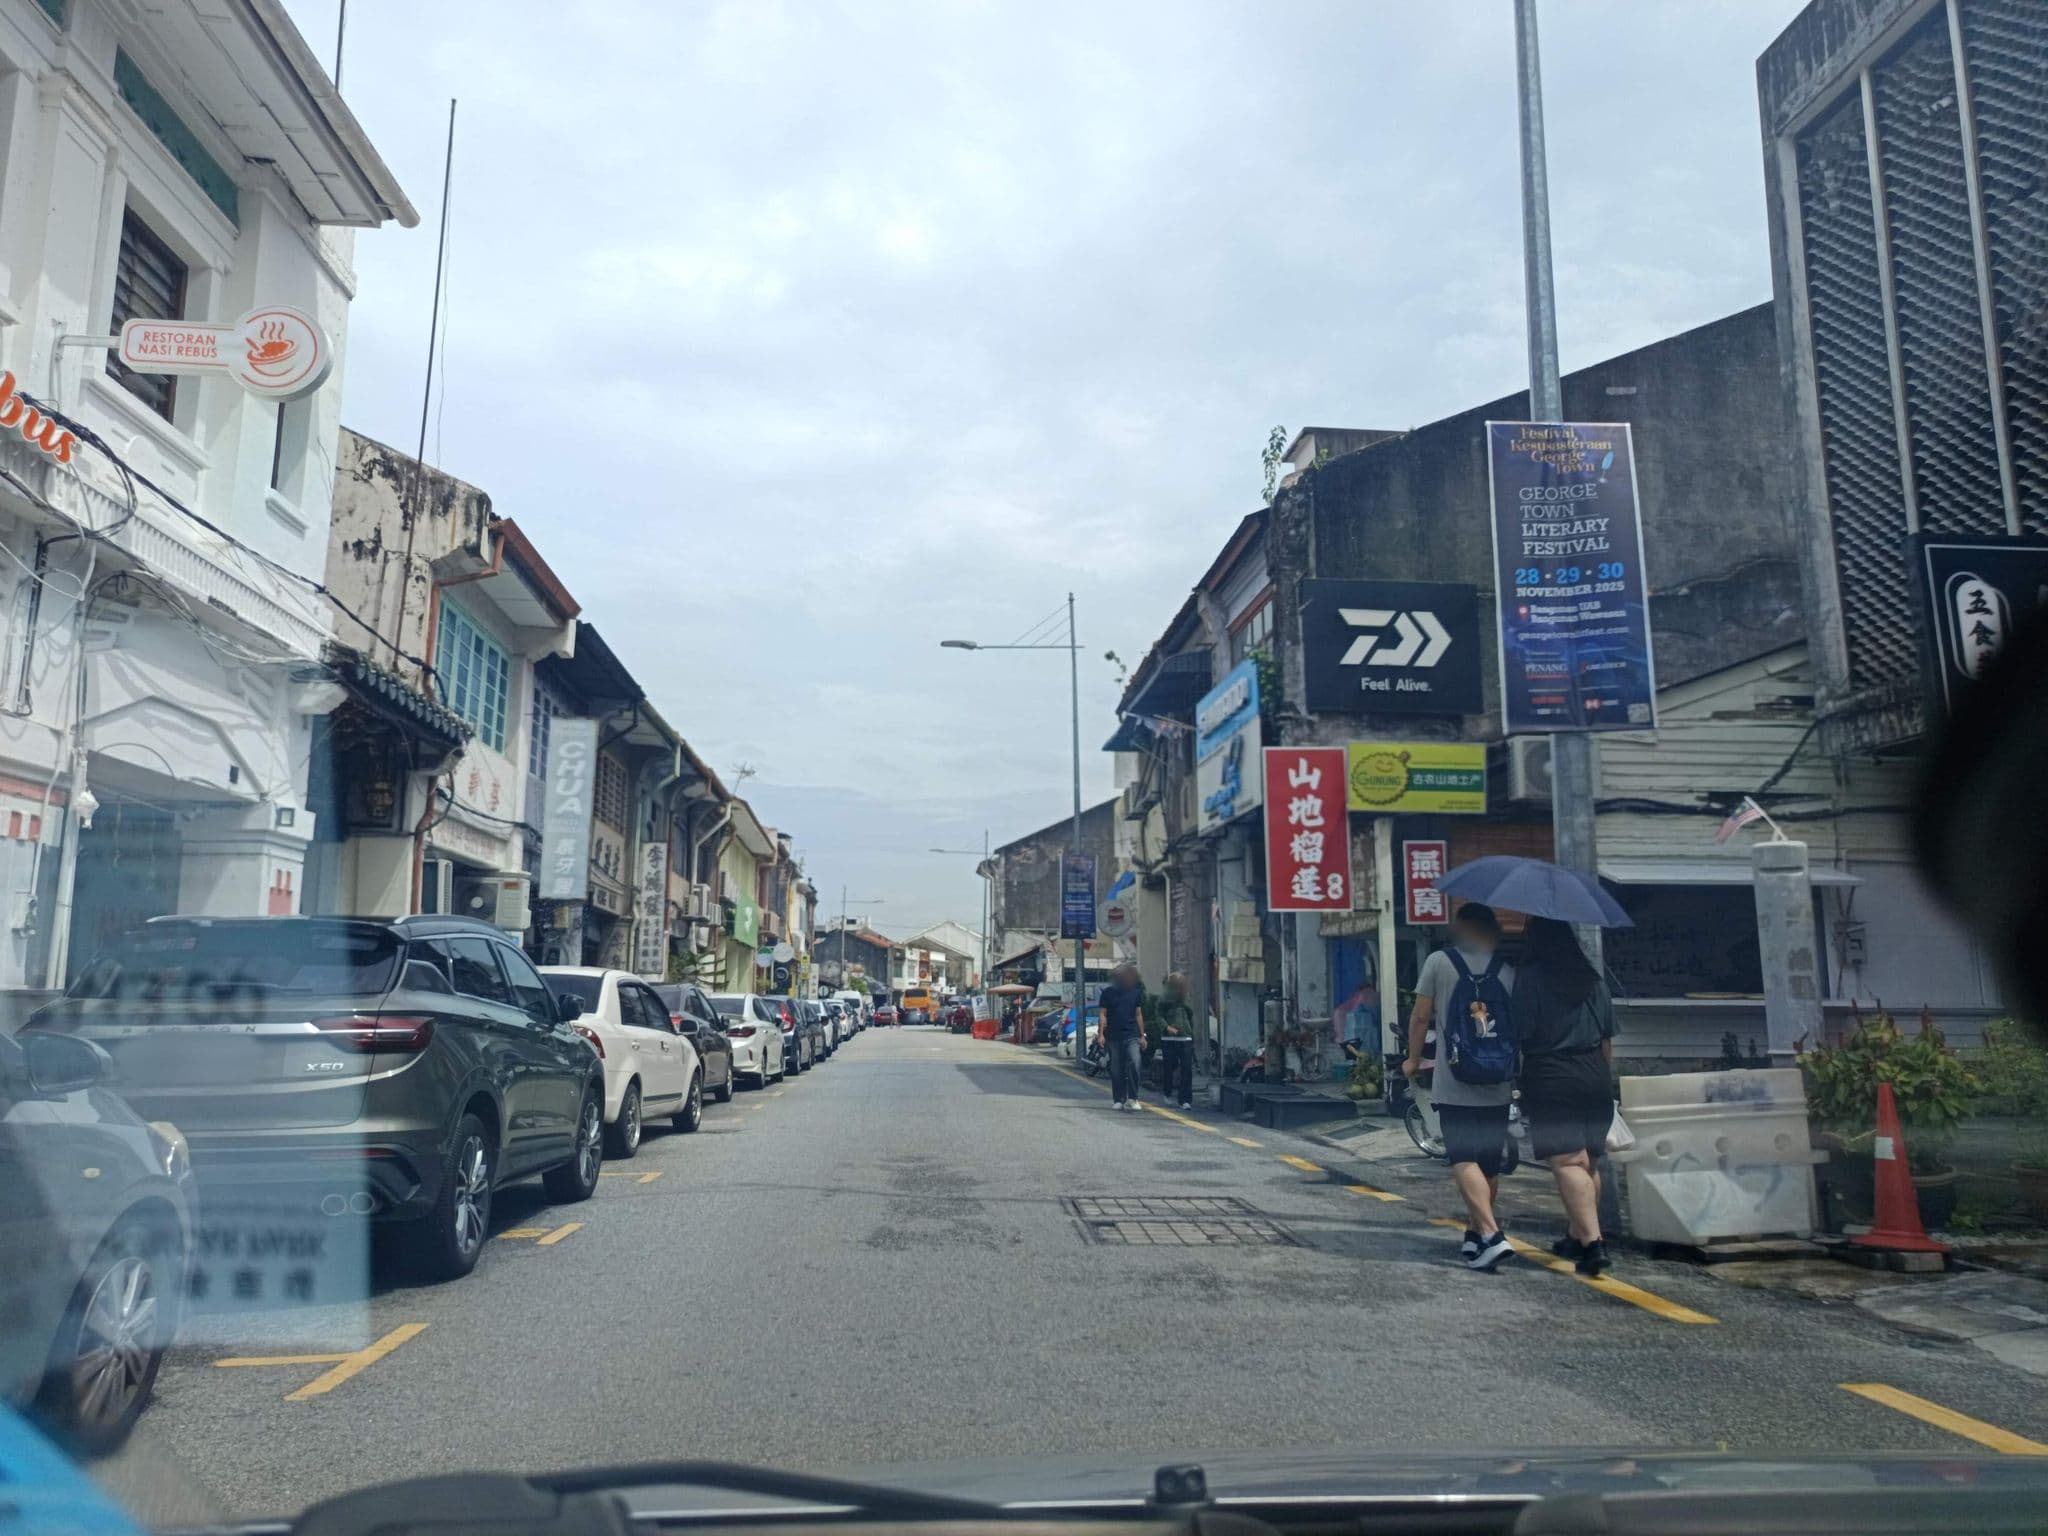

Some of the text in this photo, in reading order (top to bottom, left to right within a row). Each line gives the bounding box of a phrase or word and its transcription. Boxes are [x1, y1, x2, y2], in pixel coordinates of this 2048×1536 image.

[142, 330, 217, 347] RESTORAN
[138, 344, 218, 358] NASI REBUS
[1521, 427, 1576, 440] Festival
[1530, 450, 1586, 464] George
[1556, 462, 1595, 474] Town
[1519, 483, 1598, 501] GEORGE
[1520, 503, 1575, 519] TOWN
[1521, 518, 1609, 537] LITERARY
[1523, 537, 1609, 555] FESTIVAL
[1515, 562, 1624, 585] 28 29 30
[1516, 581, 1625, 598] NOVEMBER 2025
[1361, 677, 1433, 693] Feel Alive.
[555, 742, 586, 815] CHUA
[1326, 873, 1344, 900] 8
[306, 1062, 345, 1073] X50
